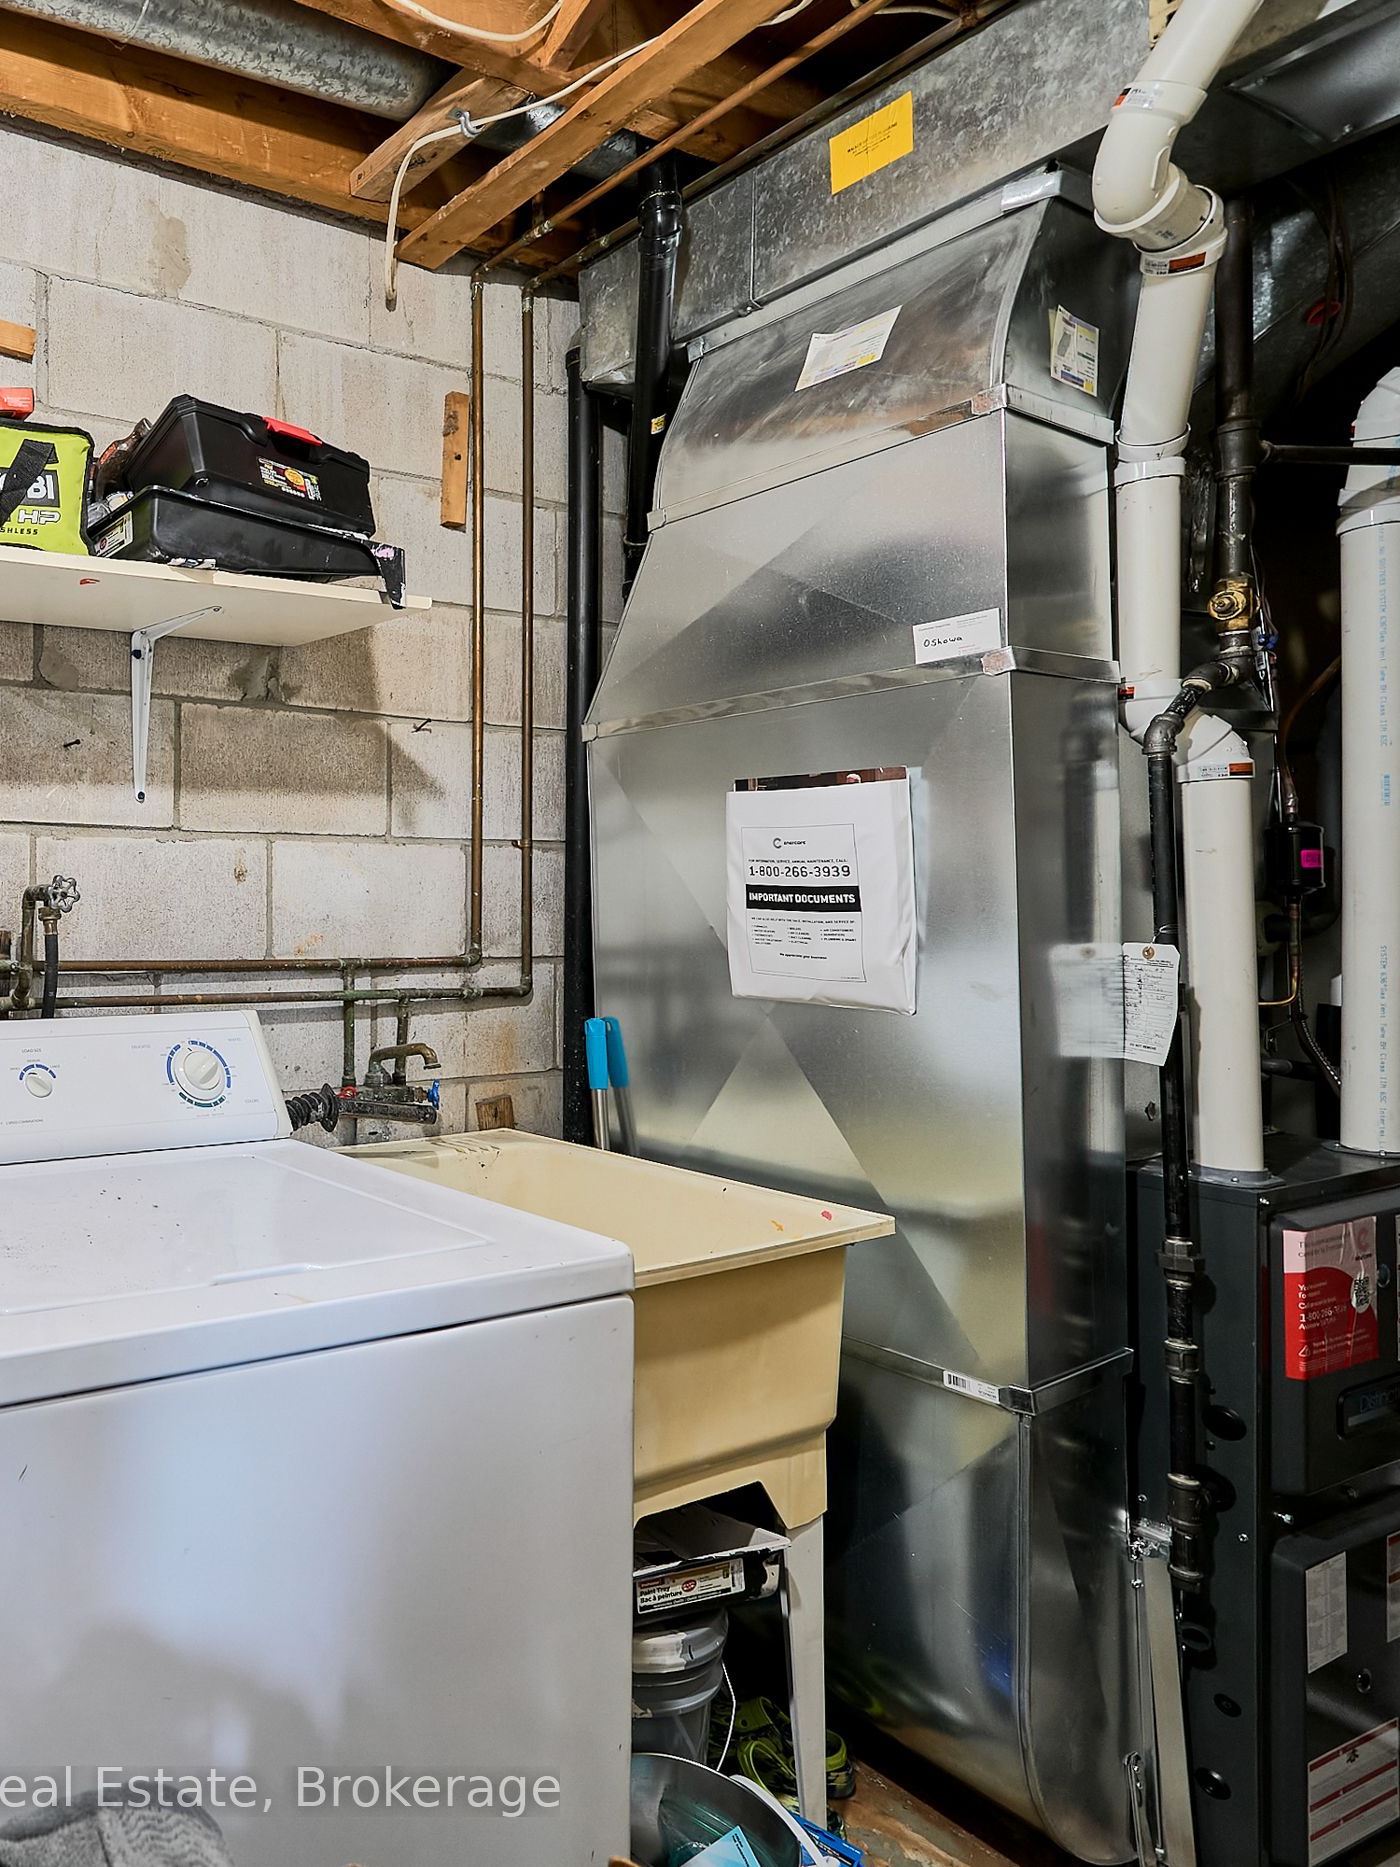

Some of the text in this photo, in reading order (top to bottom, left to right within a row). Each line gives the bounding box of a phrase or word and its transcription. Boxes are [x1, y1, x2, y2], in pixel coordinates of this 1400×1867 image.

[18, 509, 62, 525] HP
[749, 865, 851, 878] 1-800-266-3939
[748, 892, 856, 904] IMPORTANT DOCUMENTS
